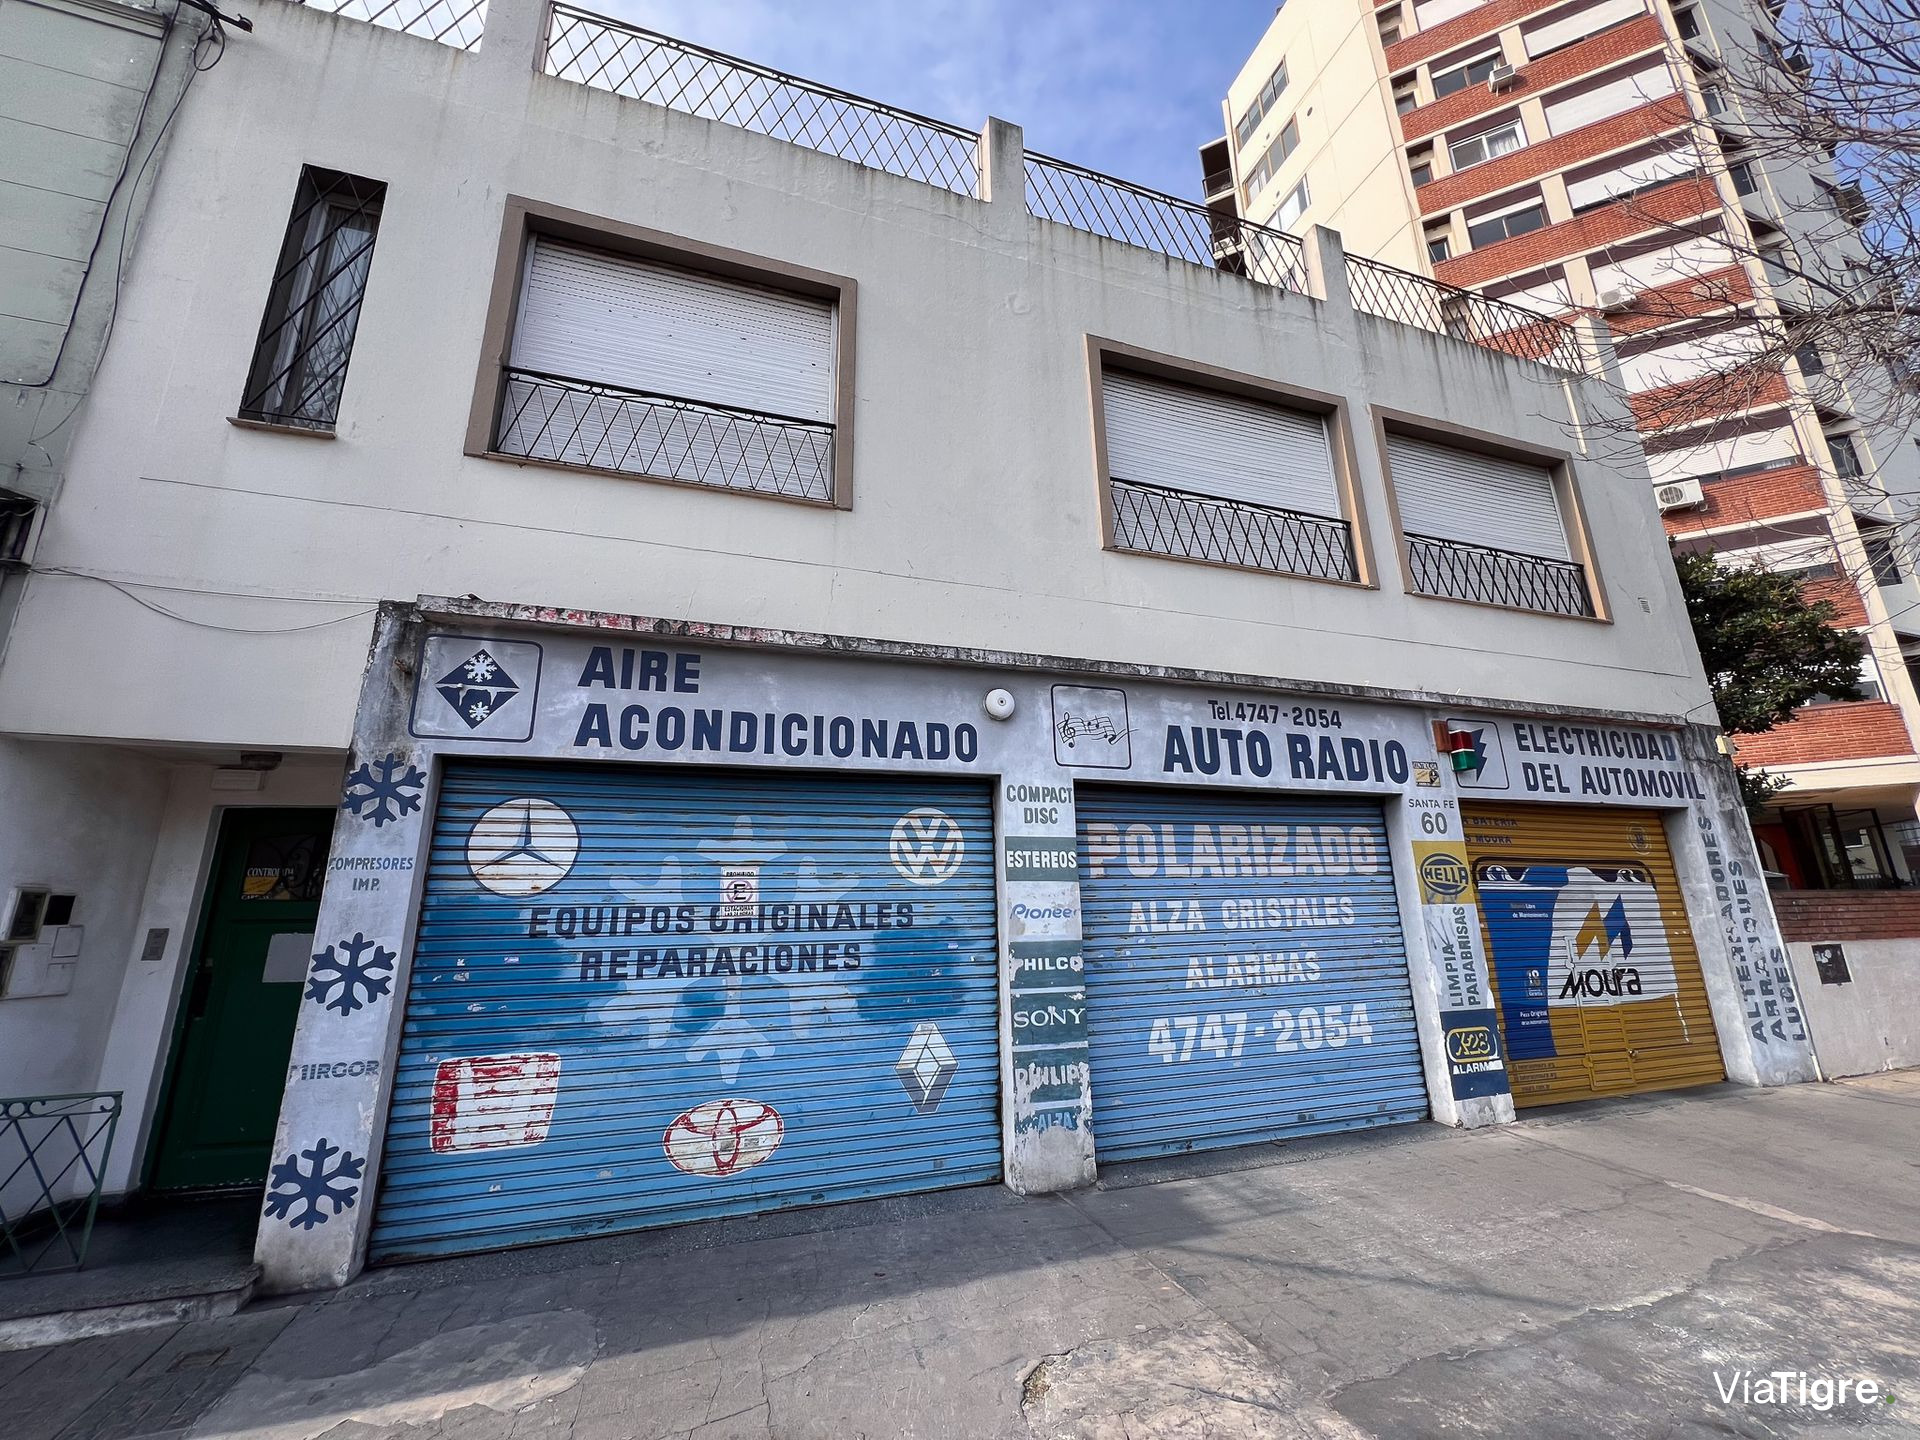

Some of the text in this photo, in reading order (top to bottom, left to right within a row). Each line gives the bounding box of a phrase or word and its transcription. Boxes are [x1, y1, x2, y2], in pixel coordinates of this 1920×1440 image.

[577, 646, 701, 694] AIRE
[574, 703, 978, 763] ACONDICIONADO
[1513, 723, 1676, 761] ELECTRICIDAD
[1163, 725, 1410, 784] AUTO RADIO
[1006, 784, 1072, 804] COMPACT
[1521, 762, 1706, 800] DEL AUTOMOVIL
[1023, 807, 1058, 824] DISC
[1408, 799, 1455, 809] SANTA FE
[1421, 811, 1448, 834] 60
[329, 857, 413, 870] COMPRESORES
[1006, 850, 1077, 869] ESTEREOS
[1086, 823, 1378, 879] POLARIZADO
[1424, 866, 1468, 886] HELLA
[529, 905, 695, 939] EQUIPOS
[1128, 897, 1355, 933] ALZA CRISTALES
[580, 944, 861, 982] REPARACIONES
[1185, 951, 1321, 989] ALARMAS
[1453, 906, 1481, 1006] PARABRISAS
[1728, 861, 1788, 1042] ARRAQUES
[1442, 943, 1465, 1007] LIMPIA
[1013, 1007, 1085, 1028] SONY
[1015, 1062, 1089, 1087] PHILIPS
